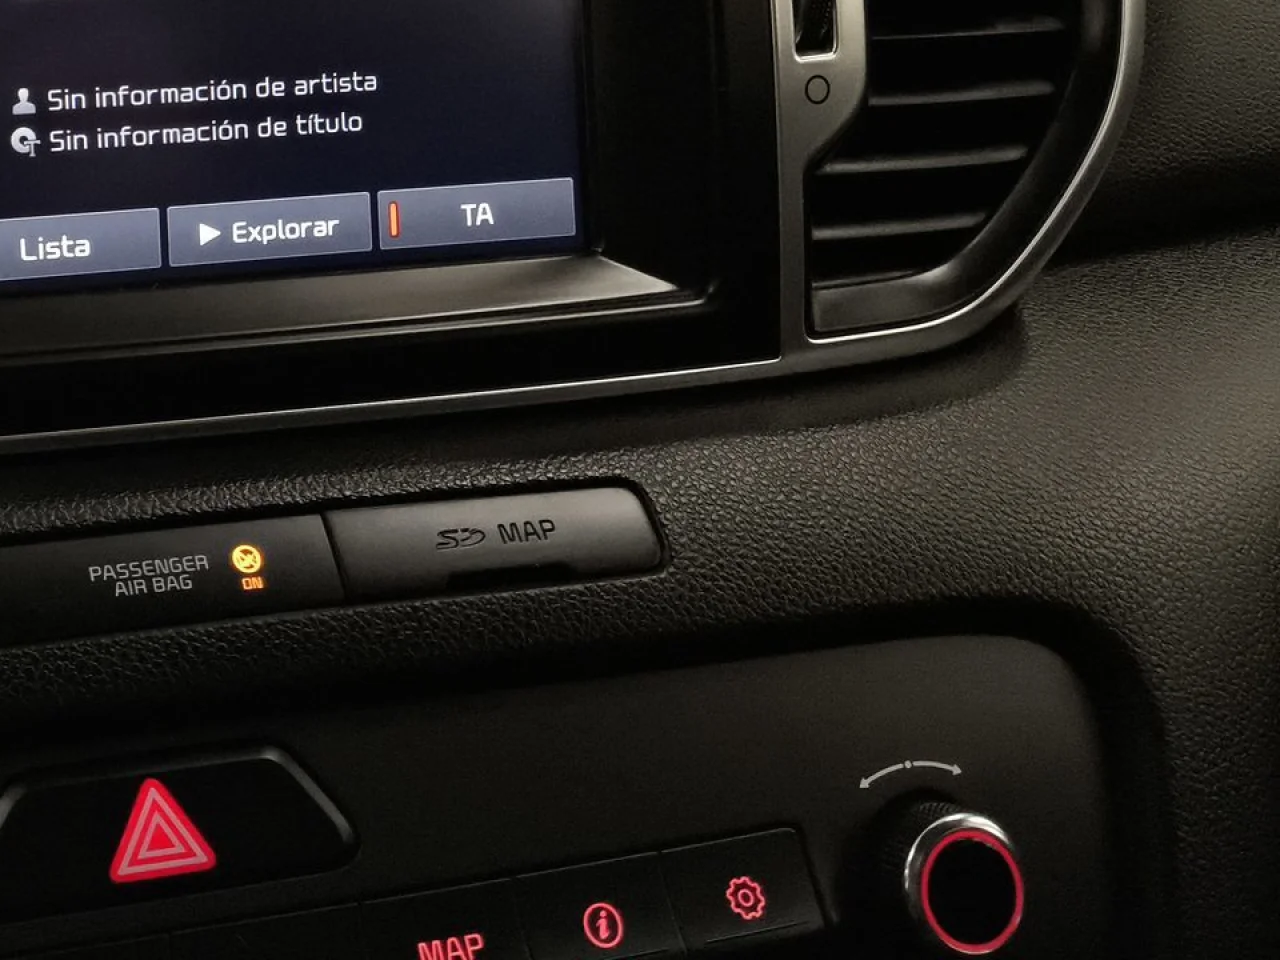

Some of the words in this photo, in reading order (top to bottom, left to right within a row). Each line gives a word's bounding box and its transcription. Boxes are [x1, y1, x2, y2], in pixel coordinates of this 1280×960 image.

[47, 88, 86, 112] Sin
[94, 79, 247, 110] información
[255, 76, 286, 98] de
[293, 71, 378, 96] artista
[49, 129, 89, 153] Sin
[96, 119, 250, 149] información
[257, 116, 288, 138] de
[296, 111, 363, 135] título
[460, 203, 495, 227] TA
[232, 218, 340, 245] Explorar
[20, 234, 91, 261] Lista
[496, 519, 557, 545] MAP
[88, 554, 210, 582] PASSENGER
[114, 578, 148, 597] AIR
[151, 573, 194, 594] BAG
[241, 575, 264, 591] ON
[418, 931, 484, 960] MAP
